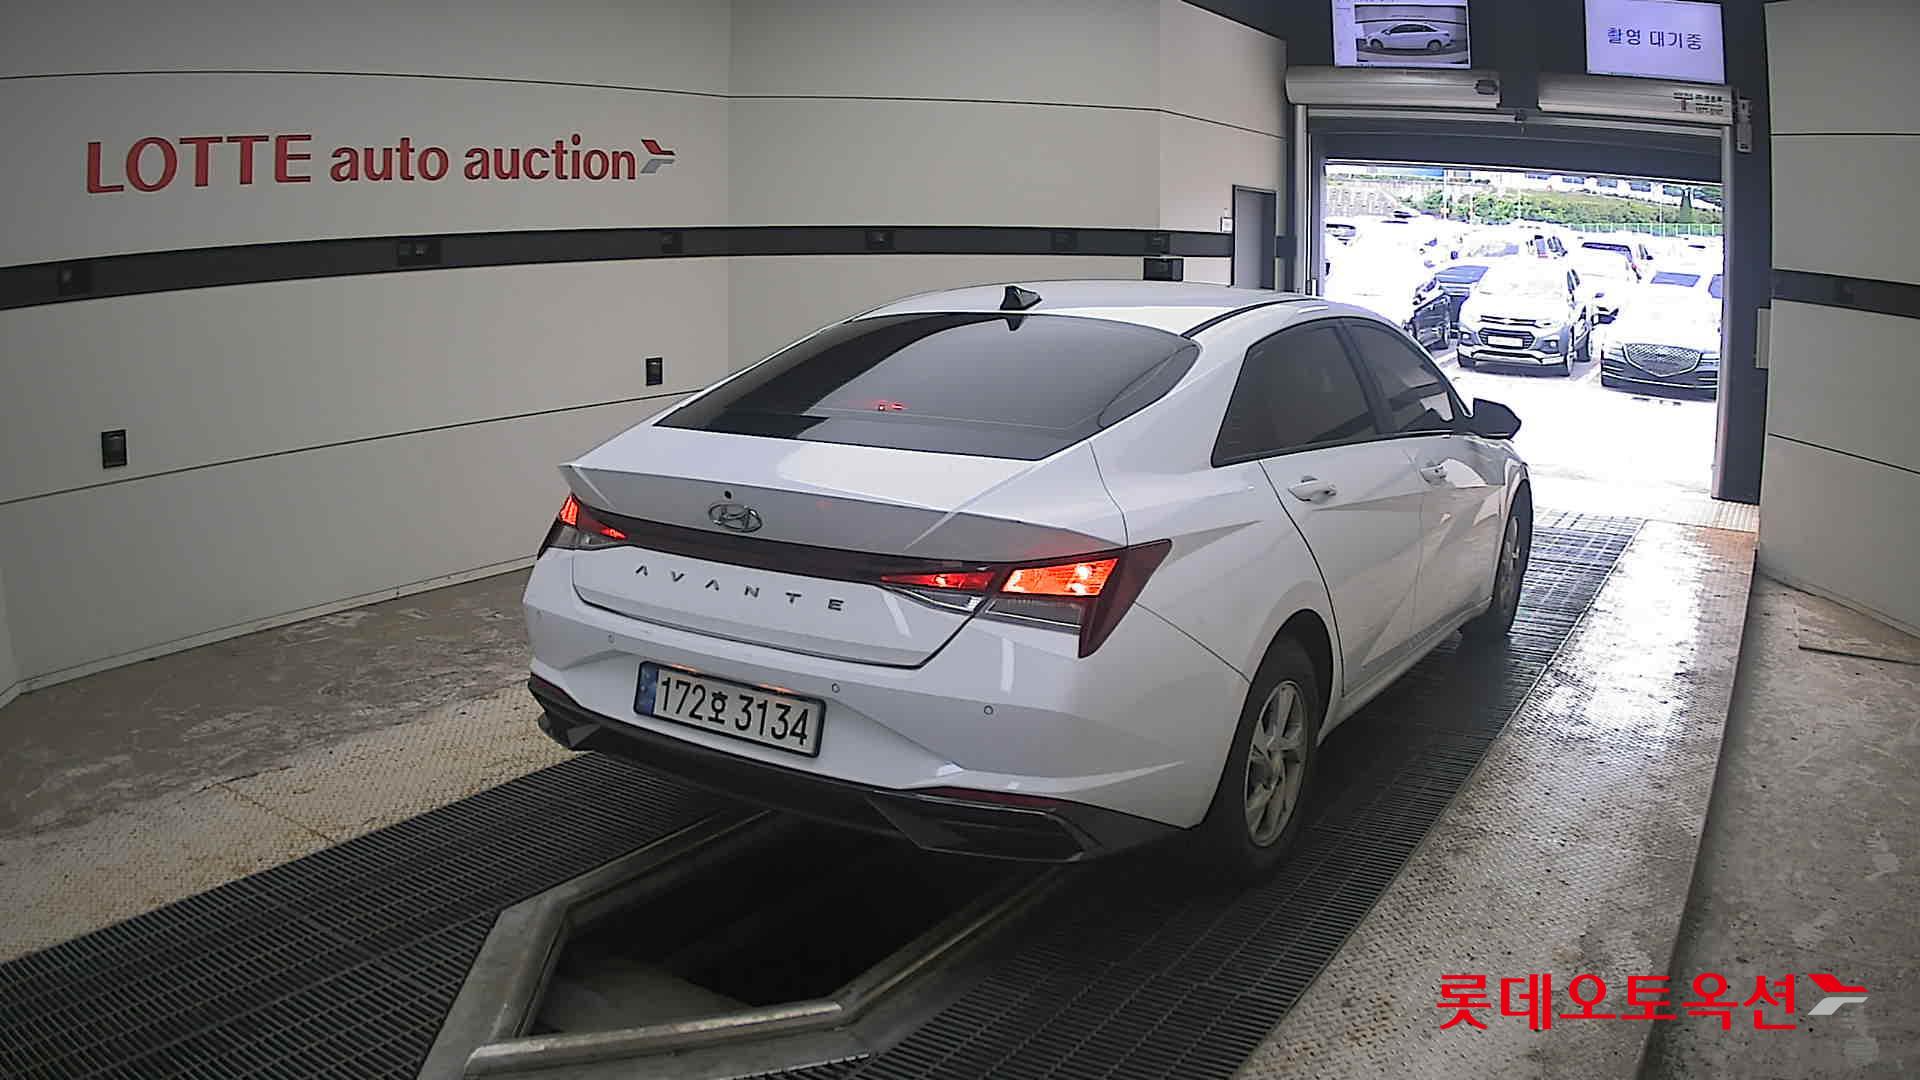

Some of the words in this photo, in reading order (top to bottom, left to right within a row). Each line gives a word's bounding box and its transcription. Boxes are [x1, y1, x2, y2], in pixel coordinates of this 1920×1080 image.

[1649, 31, 1702, 50] 대기중
[86, 134, 312, 193] LOTTE
[329, 137, 449, 182] auto
[463, 133, 637, 181] auction
[635, 564, 844, 612] AVANTE
[661, 676, 728, 725] 172호
[734, 694, 809, 747] 3134
